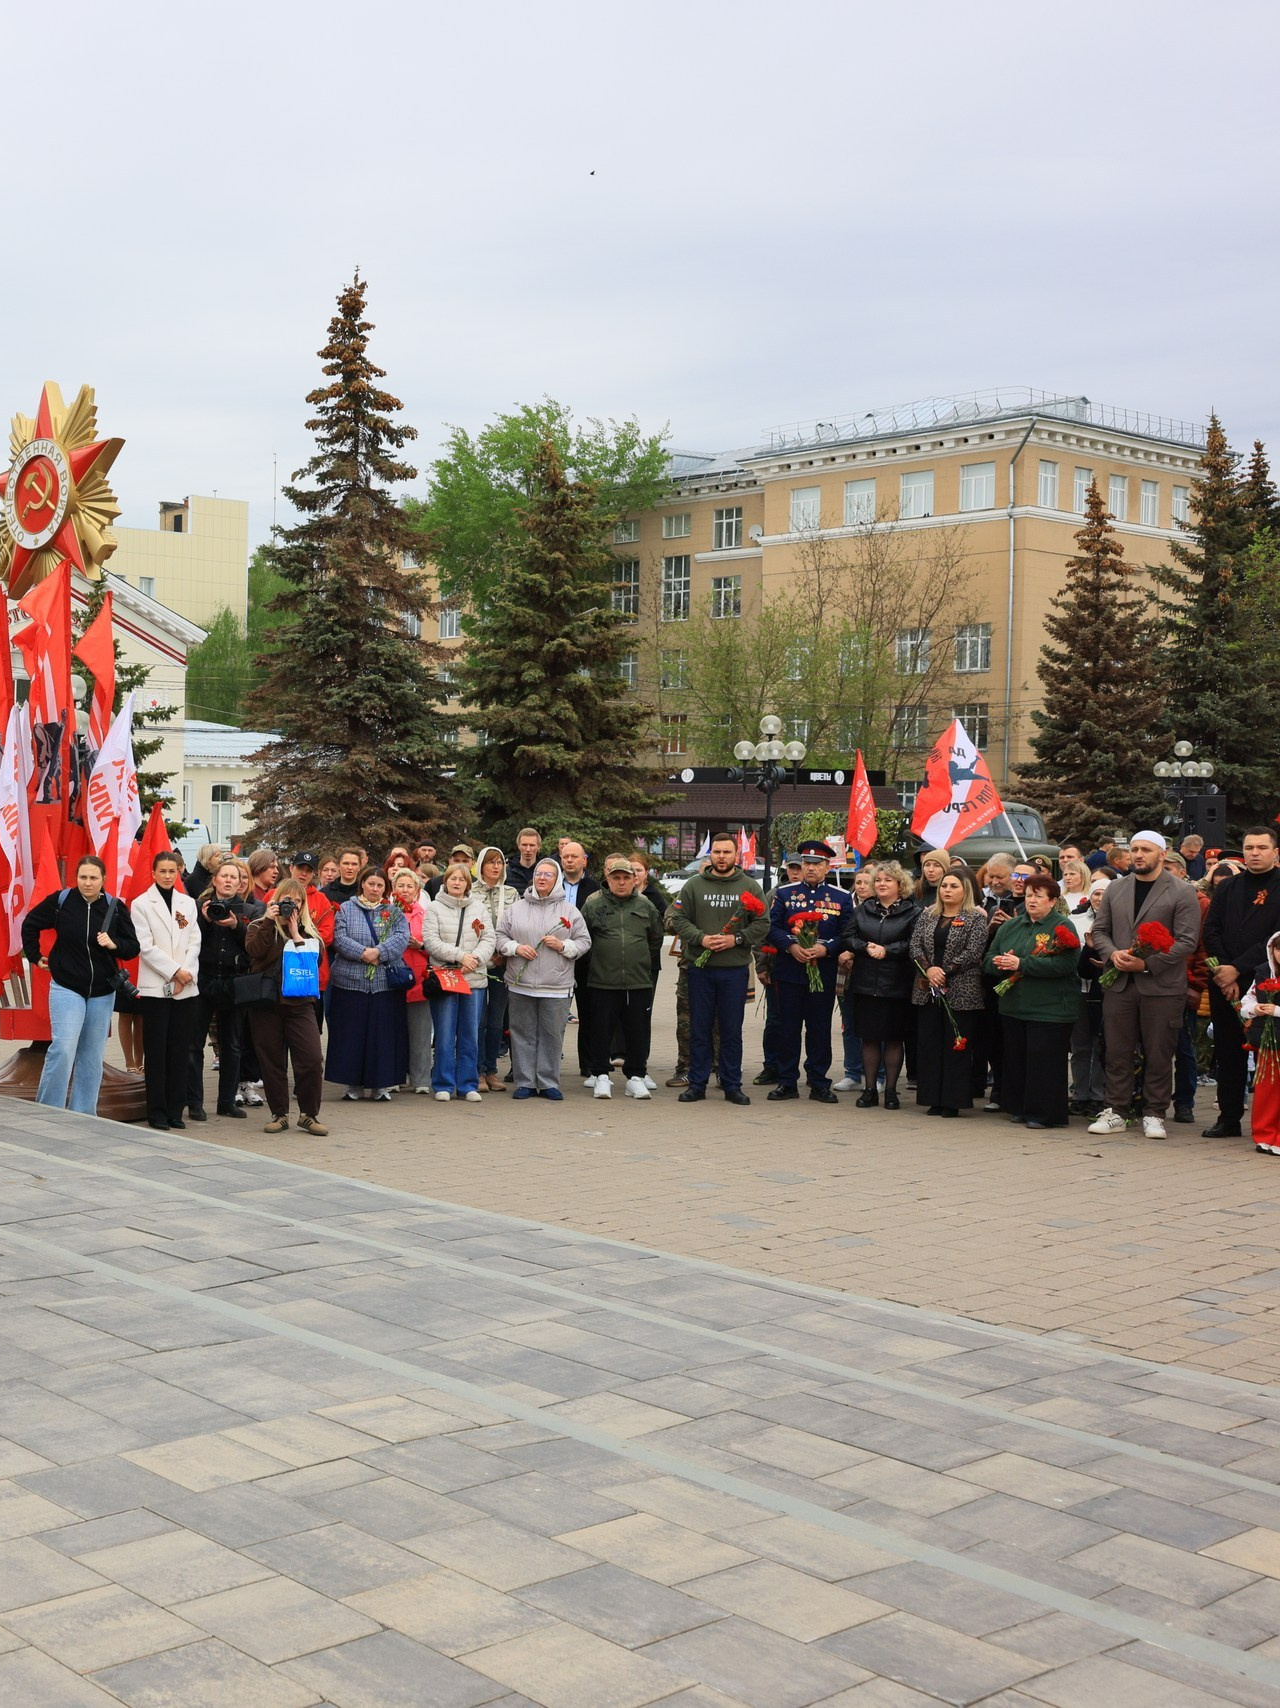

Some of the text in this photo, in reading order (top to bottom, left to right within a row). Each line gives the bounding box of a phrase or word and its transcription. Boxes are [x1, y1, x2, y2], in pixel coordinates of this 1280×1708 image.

[6, 441, 63, 542] ОТЕЧЕСТВЕННАЯ
[710, 900, 732, 908] ФРОНТ
[289, 967, 314, 976] ESTEL
